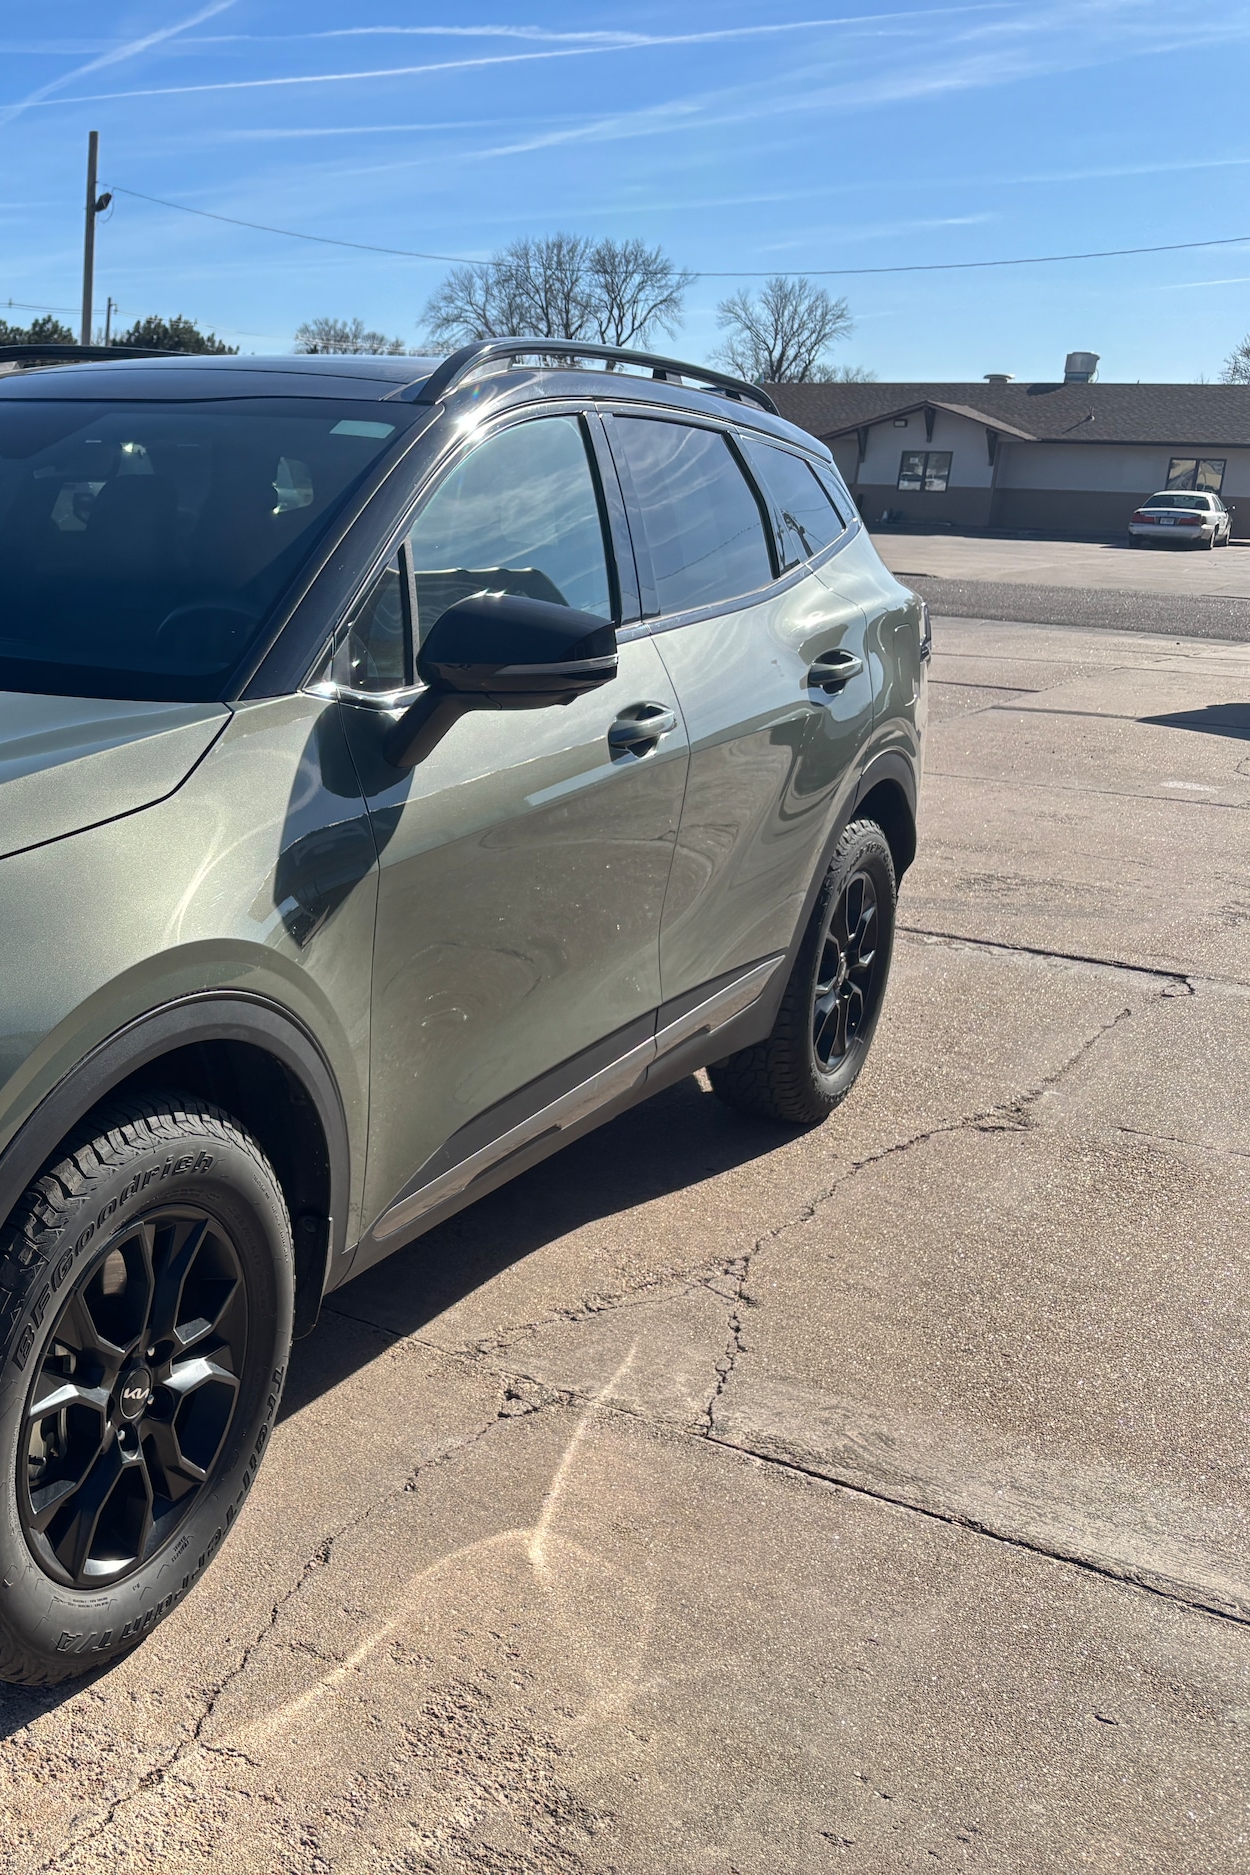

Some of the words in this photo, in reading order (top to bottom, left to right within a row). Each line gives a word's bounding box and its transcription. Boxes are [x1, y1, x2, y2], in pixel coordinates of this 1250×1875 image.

[11, 1149, 214, 1372] BFGoodrich
[123, 1387, 150, 1400] KIA
[56, 1630, 113, 1654] T/A
